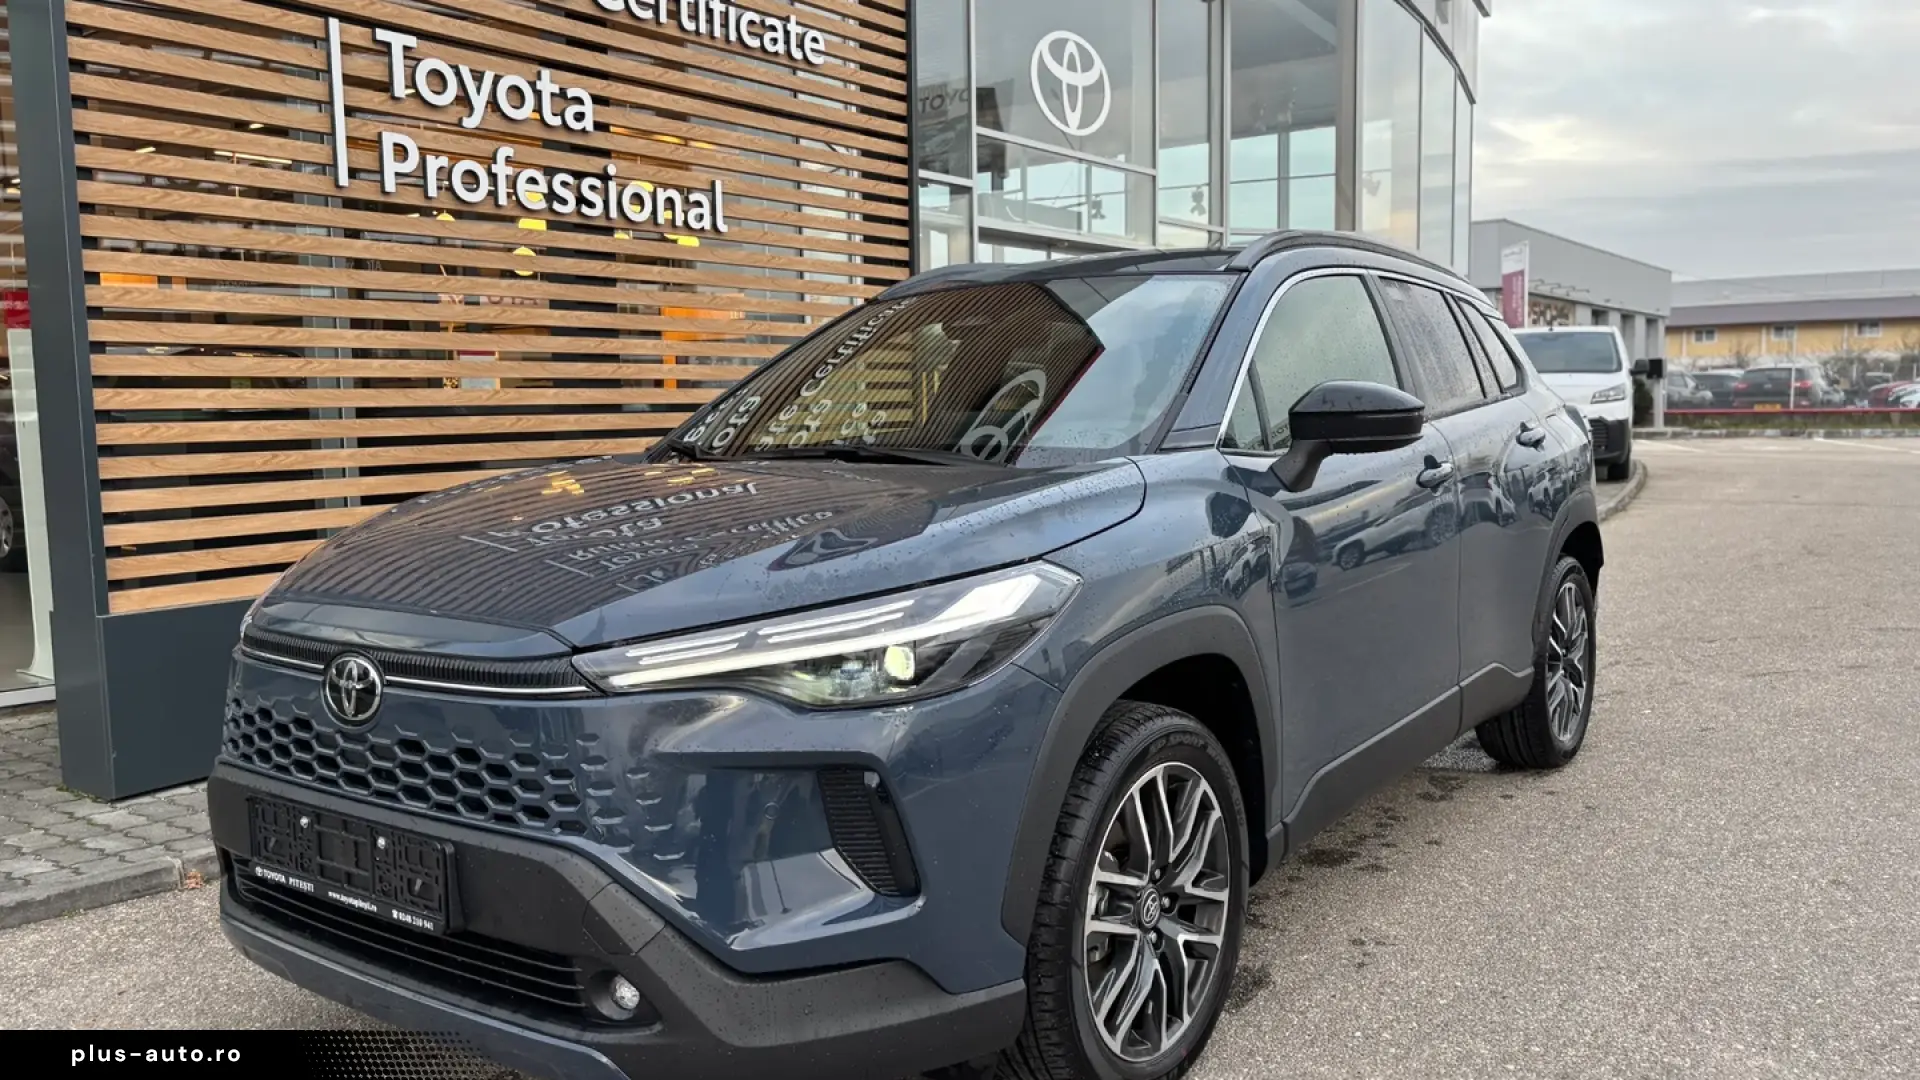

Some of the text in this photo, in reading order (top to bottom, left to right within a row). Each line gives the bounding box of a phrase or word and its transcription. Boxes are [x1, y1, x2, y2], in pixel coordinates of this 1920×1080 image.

[374, 28, 595, 133] Toyota
[379, 131, 728, 234] Professional
[263, 869, 286, 883] TOYOTA
